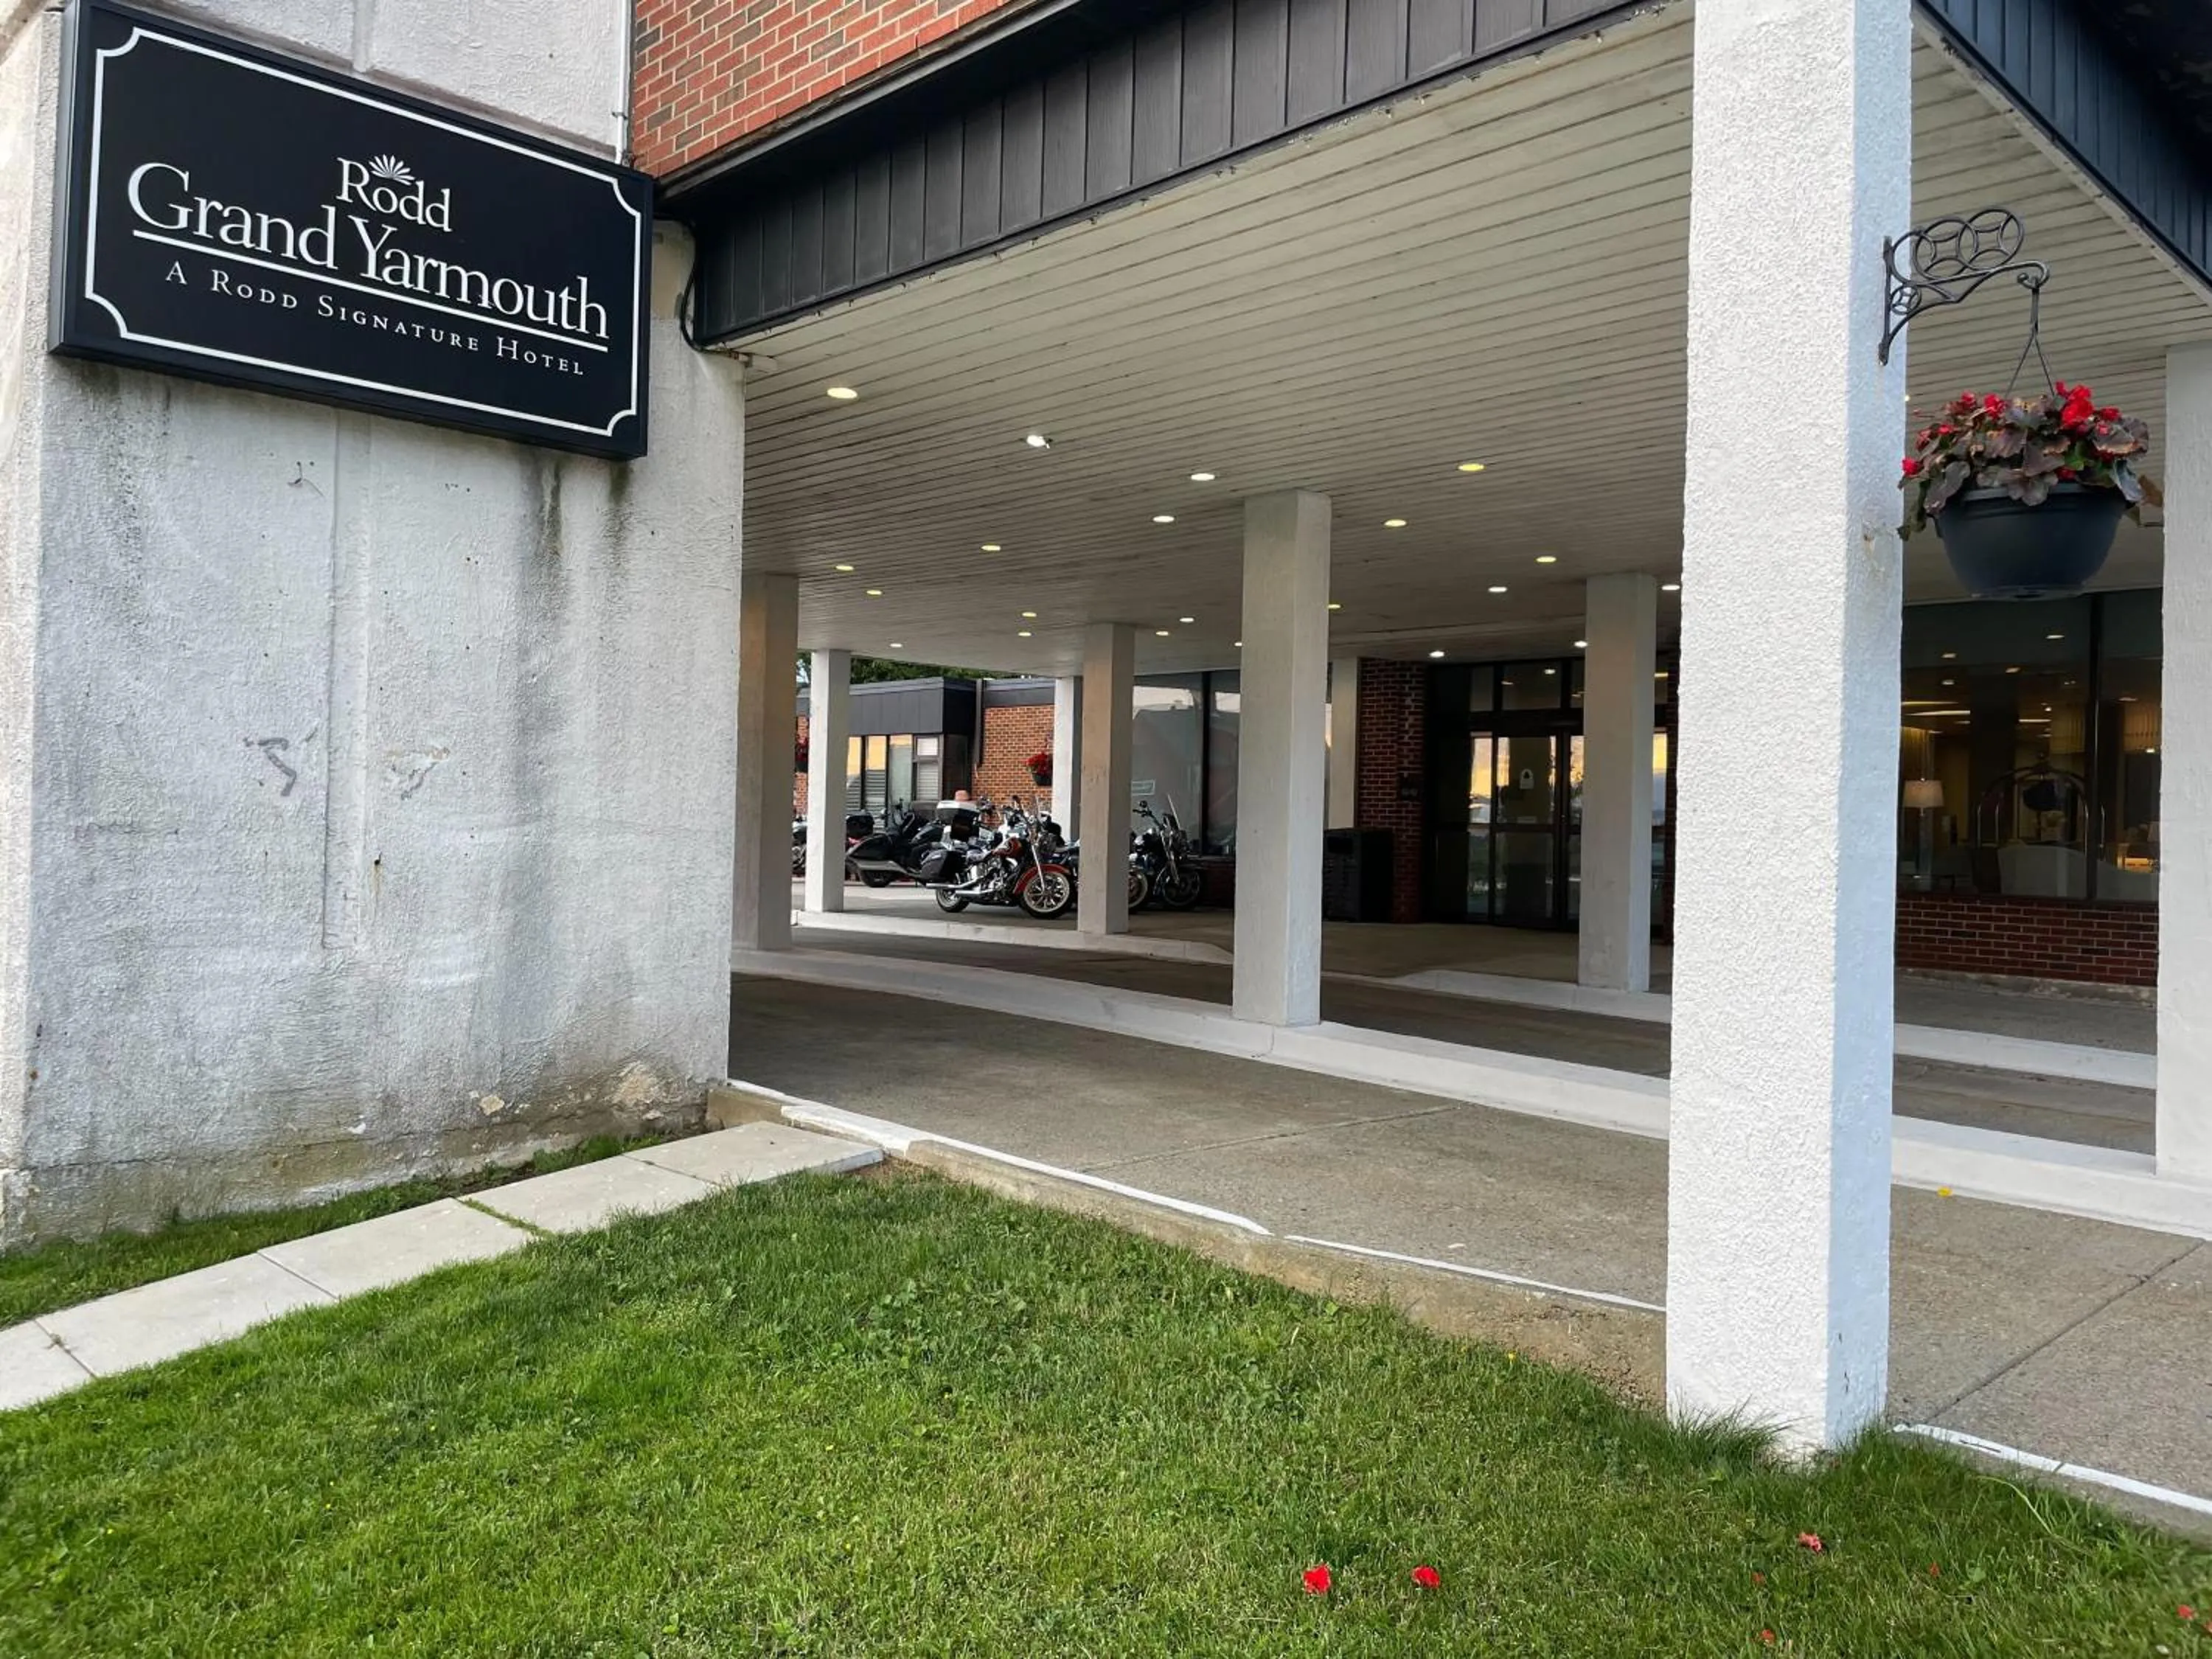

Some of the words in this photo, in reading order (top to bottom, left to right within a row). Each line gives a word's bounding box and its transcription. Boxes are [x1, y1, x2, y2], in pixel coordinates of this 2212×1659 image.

[335, 157, 452, 232] Rodd
[128, 162, 338, 270] Grand
[347, 215, 609, 339] Yarmouth
[165, 261, 187, 285] A
